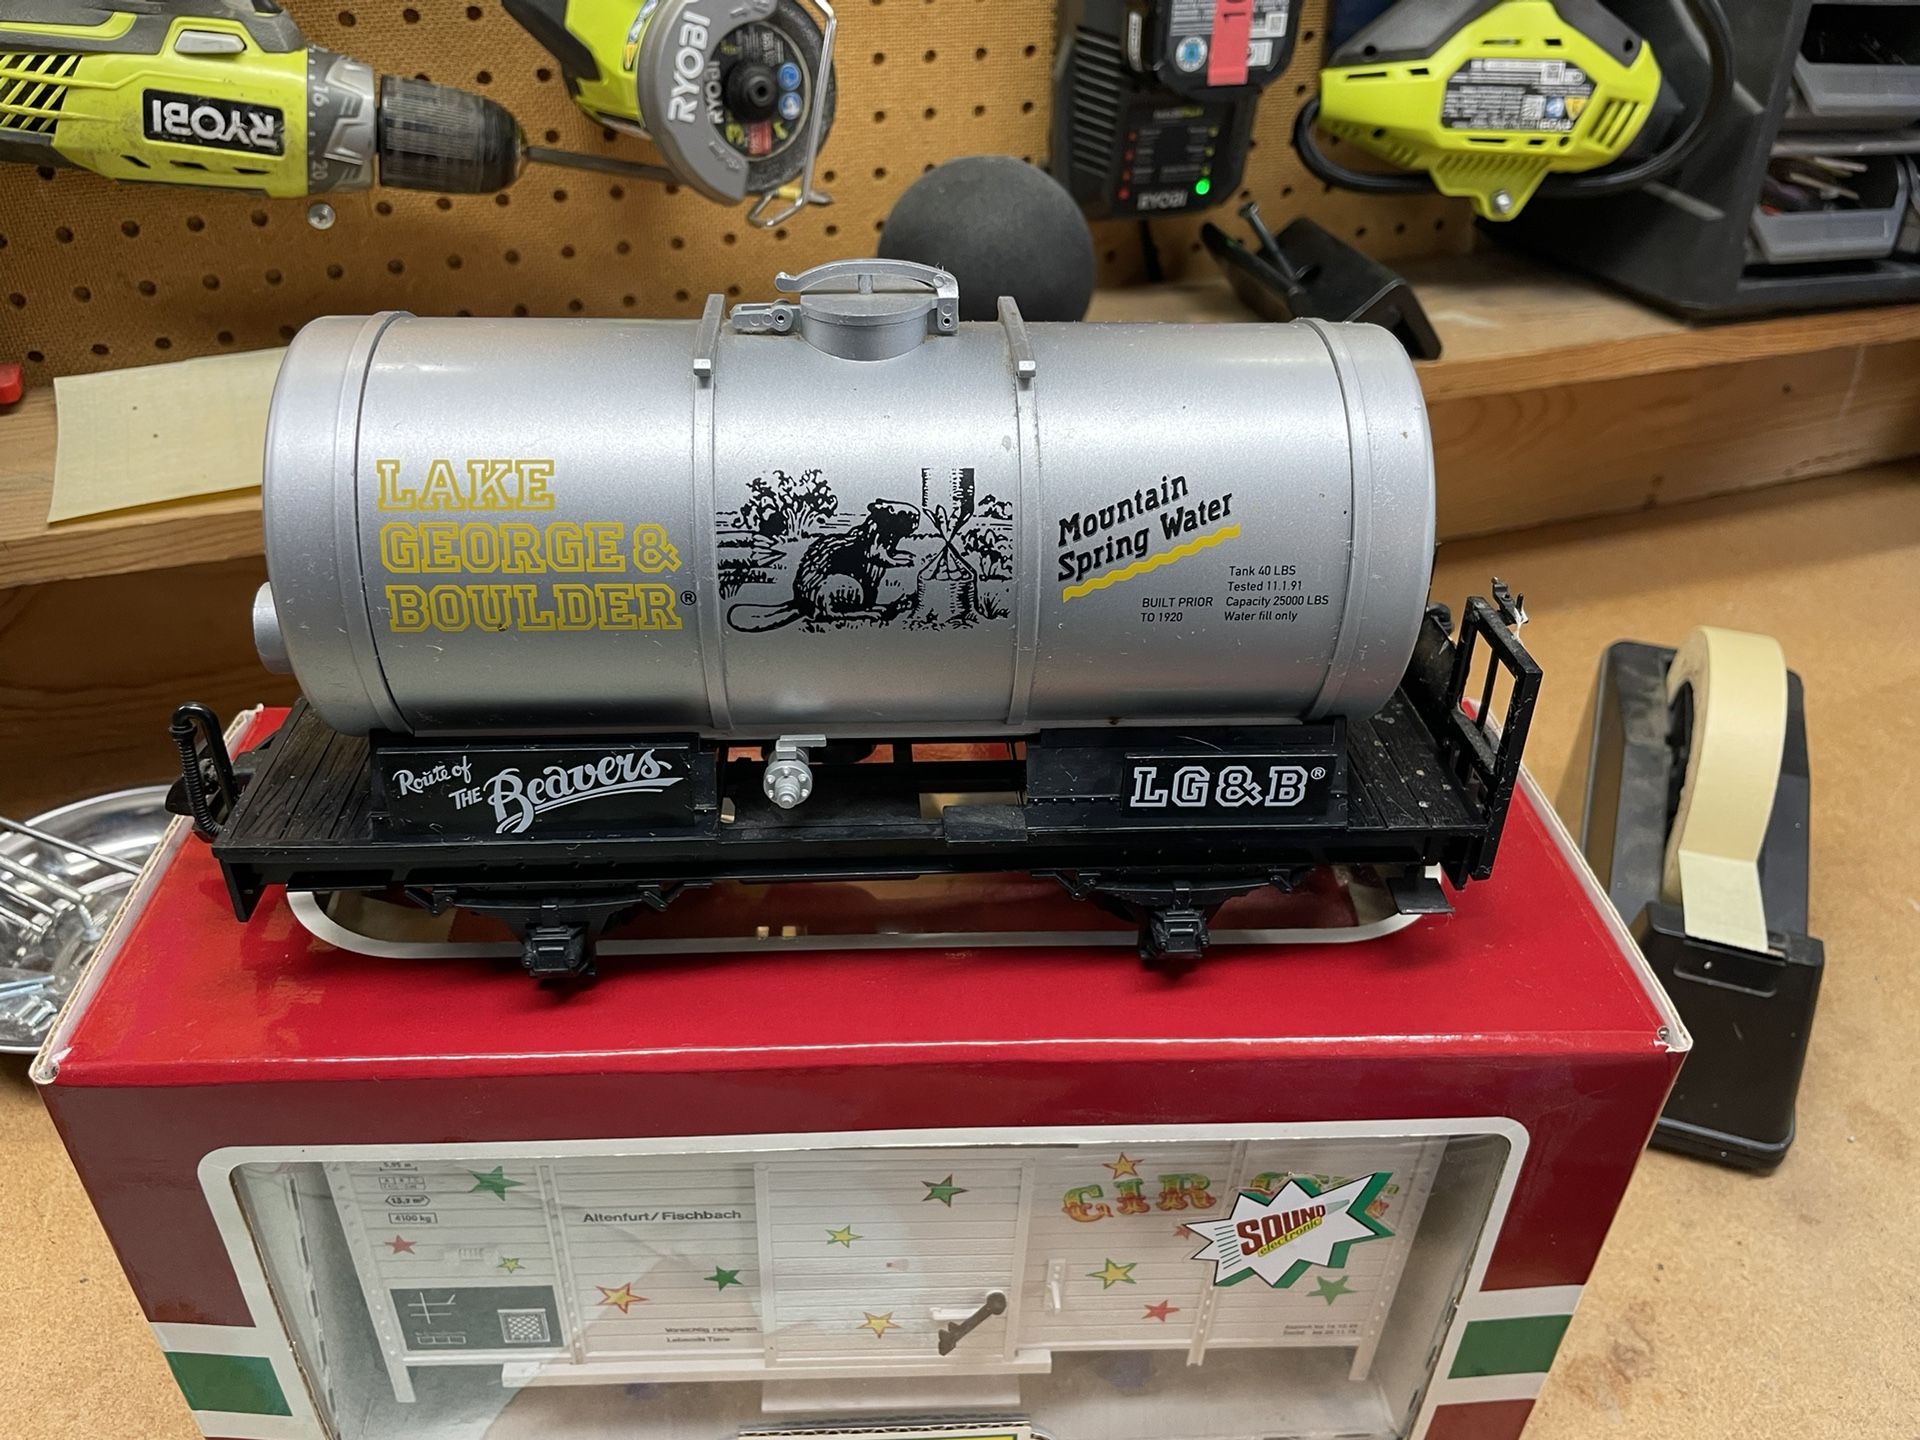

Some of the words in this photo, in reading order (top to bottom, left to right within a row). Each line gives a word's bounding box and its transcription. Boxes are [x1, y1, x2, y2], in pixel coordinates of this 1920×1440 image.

[668, 10, 711, 123] RYOBI
[312, 85, 330, 107] 16
[151, 99, 278, 148] RYOBI
[1137, 191, 1188, 210] RYOBI
[376, 459, 555, 511] LAKE
[1058, 475, 1189, 547] Mountain
[379, 522, 627, 574] GEORGE
[633, 523, 682, 573] &
[1058, 528, 1150, 582] Spring
[1159, 493, 1234, 540] Water
[1227, 581, 1264, 592] Tested
[1266, 580, 1302, 592] 11.1.91
[1229, 565, 1255, 577] Tank
[1258, 565, 1271, 576] 40
[1273, 565, 1297, 576] LBS
[1140, 612, 1156, 623] TO
[1158, 612, 1183, 622] 1920
[1142, 597, 1176, 608] BUILT
[1178, 597, 1214, 608] PRIOR
[1224, 611, 1256, 622] Water
[1258, 611, 1272, 621] fill
[1274, 611, 1298, 623] only
[1225, 596, 1271, 609] Capacity
[1273, 595, 1305, 606] 25000
[1307, 595, 1329, 606] LBS
[392, 762, 451, 795] Route
[451, 755, 472, 785] of
[449, 786, 483, 810] THE
[483, 748, 678, 834] Beavers
[1236, 1204, 1326, 1256] SOUND
[1258, 1217, 1322, 1256] electronic
